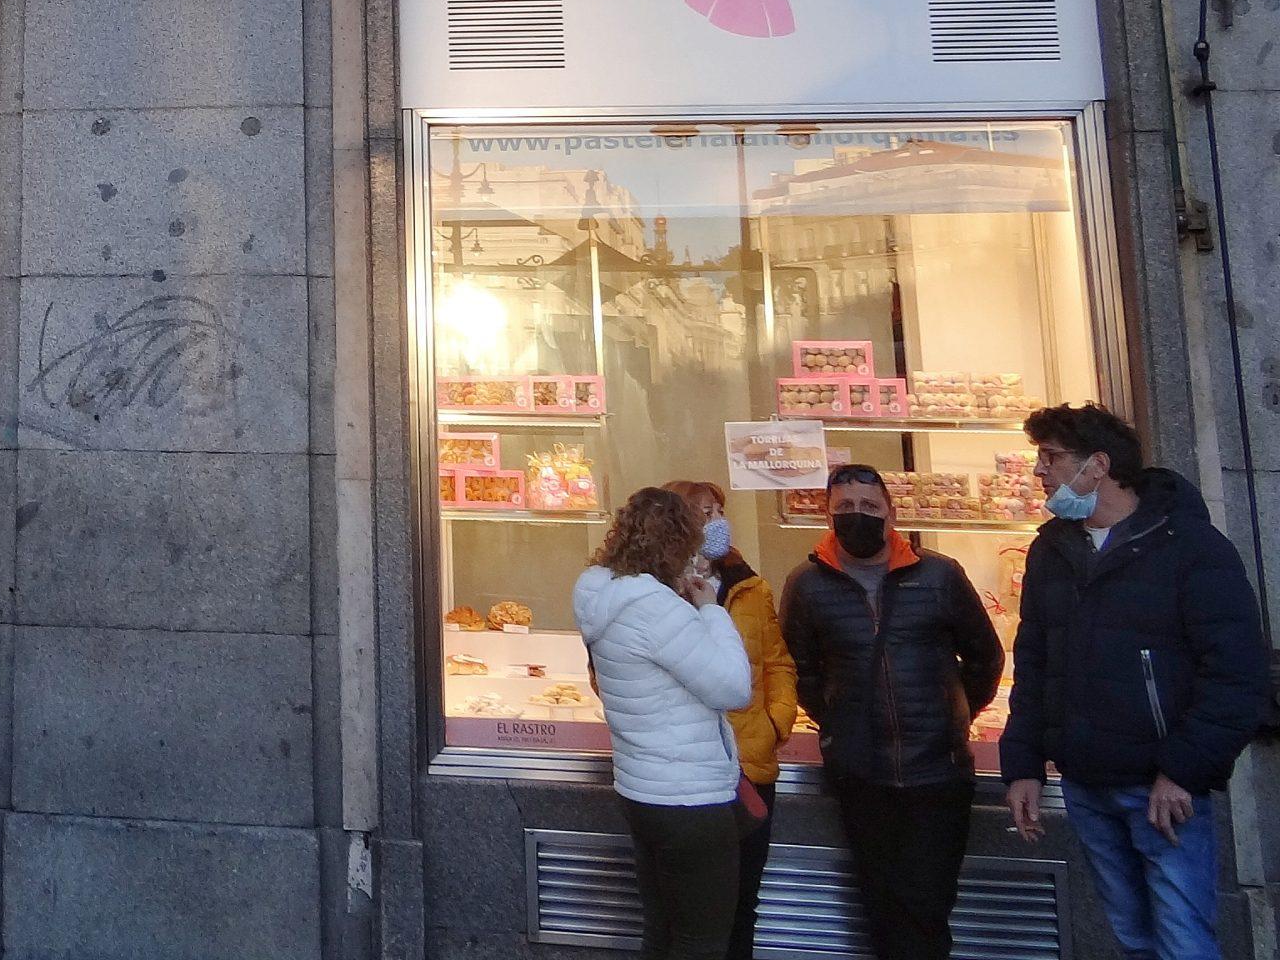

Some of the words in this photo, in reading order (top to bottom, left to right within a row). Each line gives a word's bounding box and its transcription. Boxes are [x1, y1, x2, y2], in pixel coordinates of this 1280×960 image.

[769, 447, 784, 457] DE
[497, 722, 508, 734] EL
[512, 722, 557, 736] RASTRO
